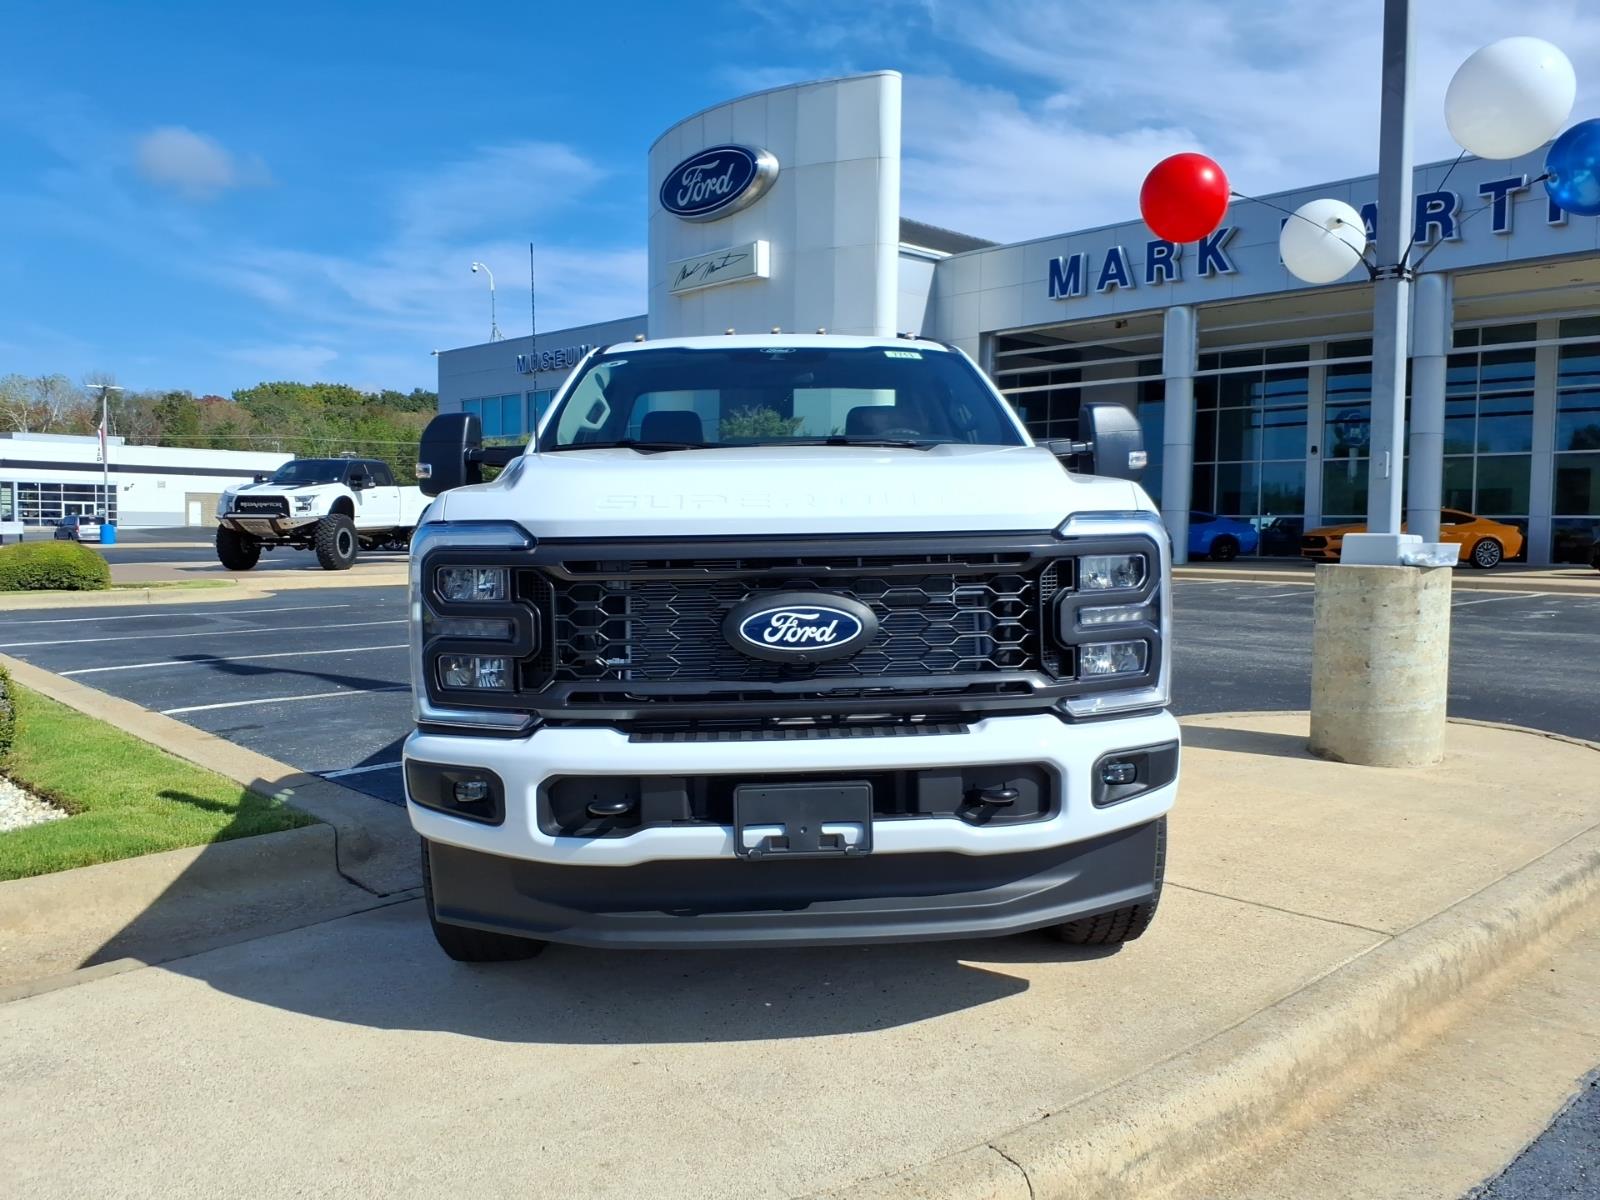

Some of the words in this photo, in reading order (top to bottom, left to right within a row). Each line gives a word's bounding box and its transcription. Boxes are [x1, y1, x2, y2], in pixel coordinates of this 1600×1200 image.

[676, 159, 736, 207] Ford
[1048, 226, 1239, 301] MARK
[763, 612, 839, 642] Ford
